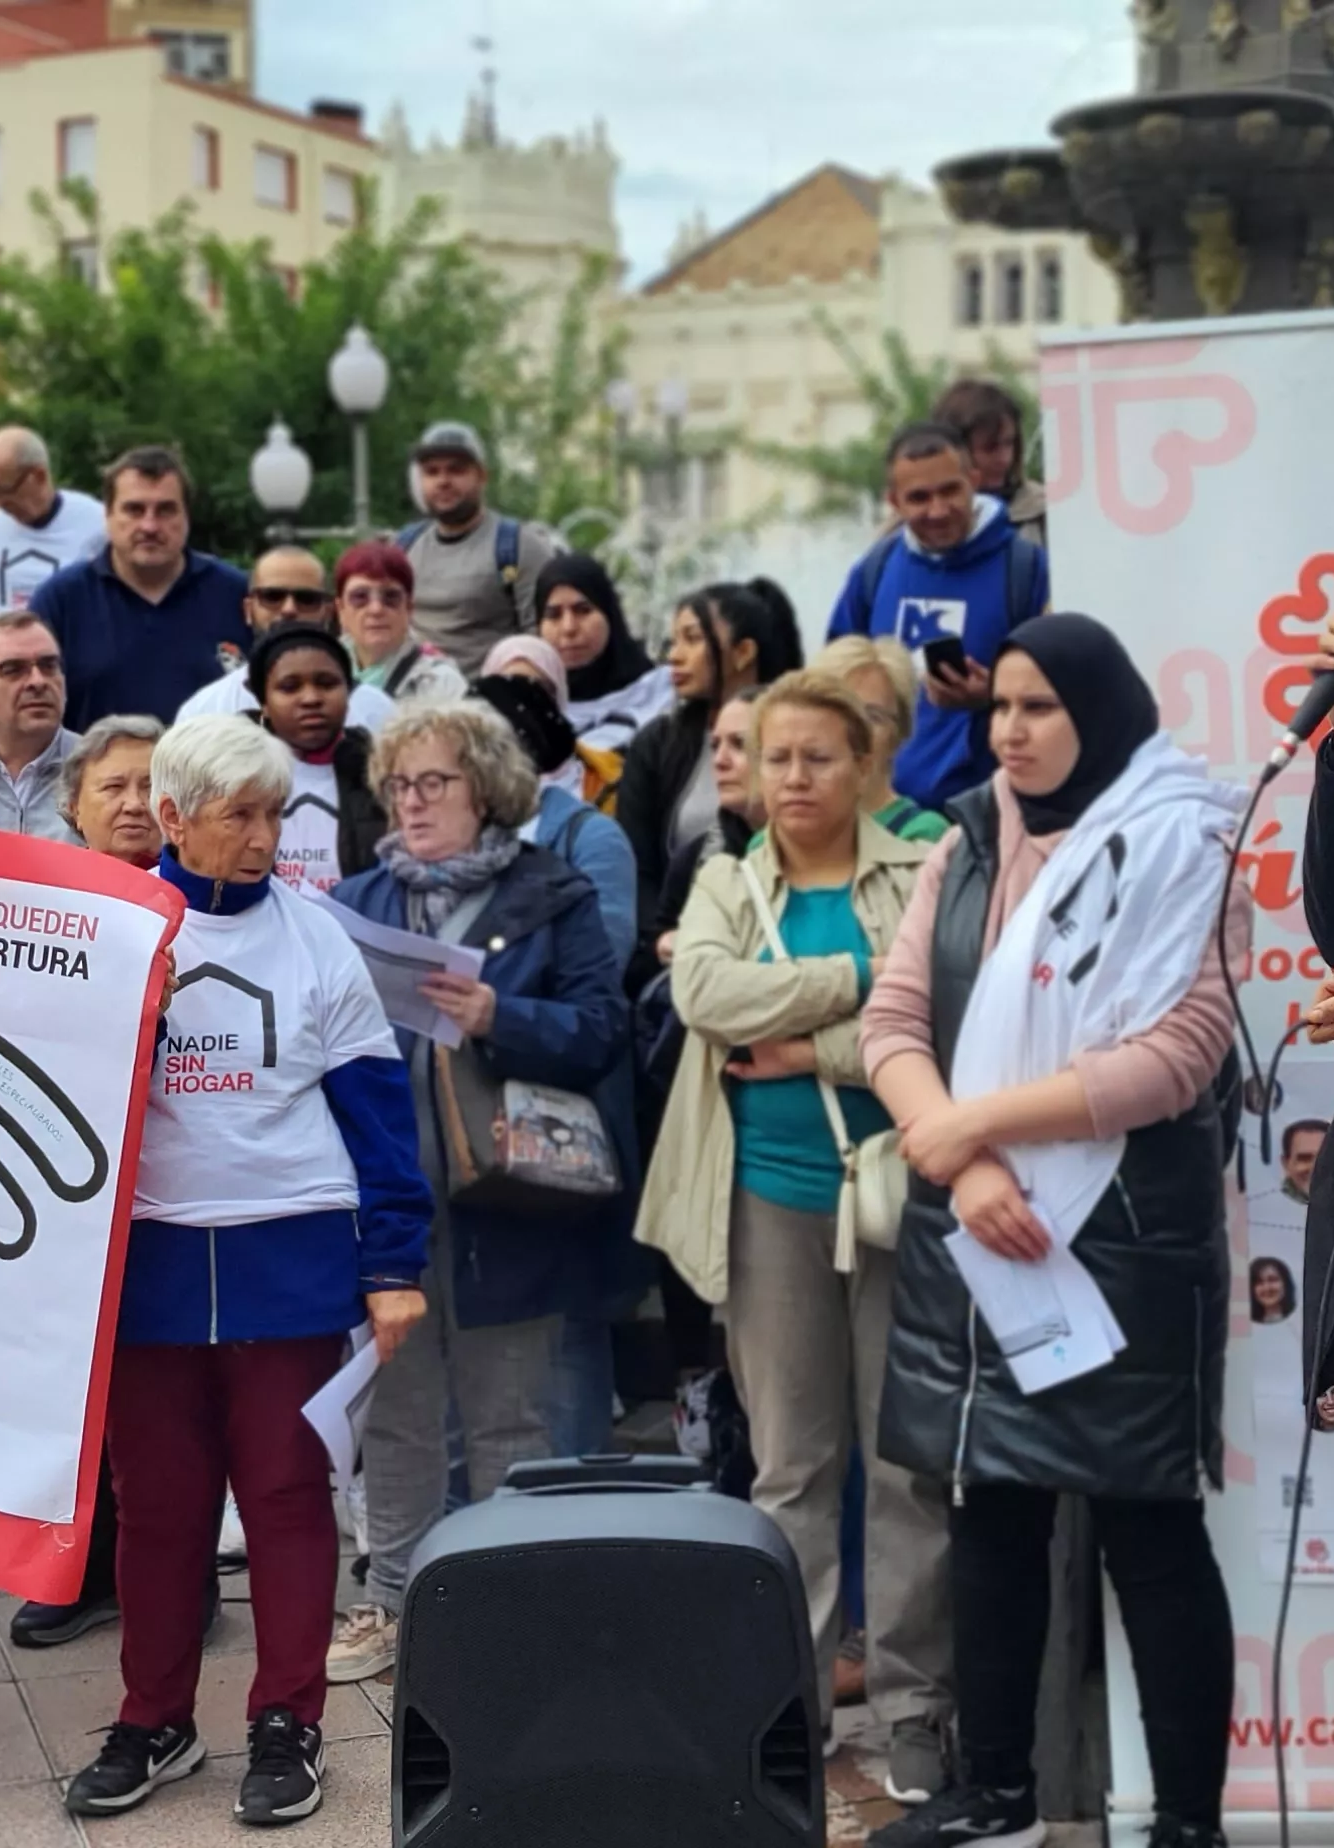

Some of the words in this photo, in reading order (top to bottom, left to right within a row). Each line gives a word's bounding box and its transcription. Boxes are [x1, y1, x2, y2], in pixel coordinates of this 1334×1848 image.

[277, 848, 330, 862] NADIE
[275, 863, 305, 877] SIN
[167, 1033, 239, 1053] NADIE
[165, 1055, 205, 1074] SIN
[164, 1072, 254, 1095] HOGAR
